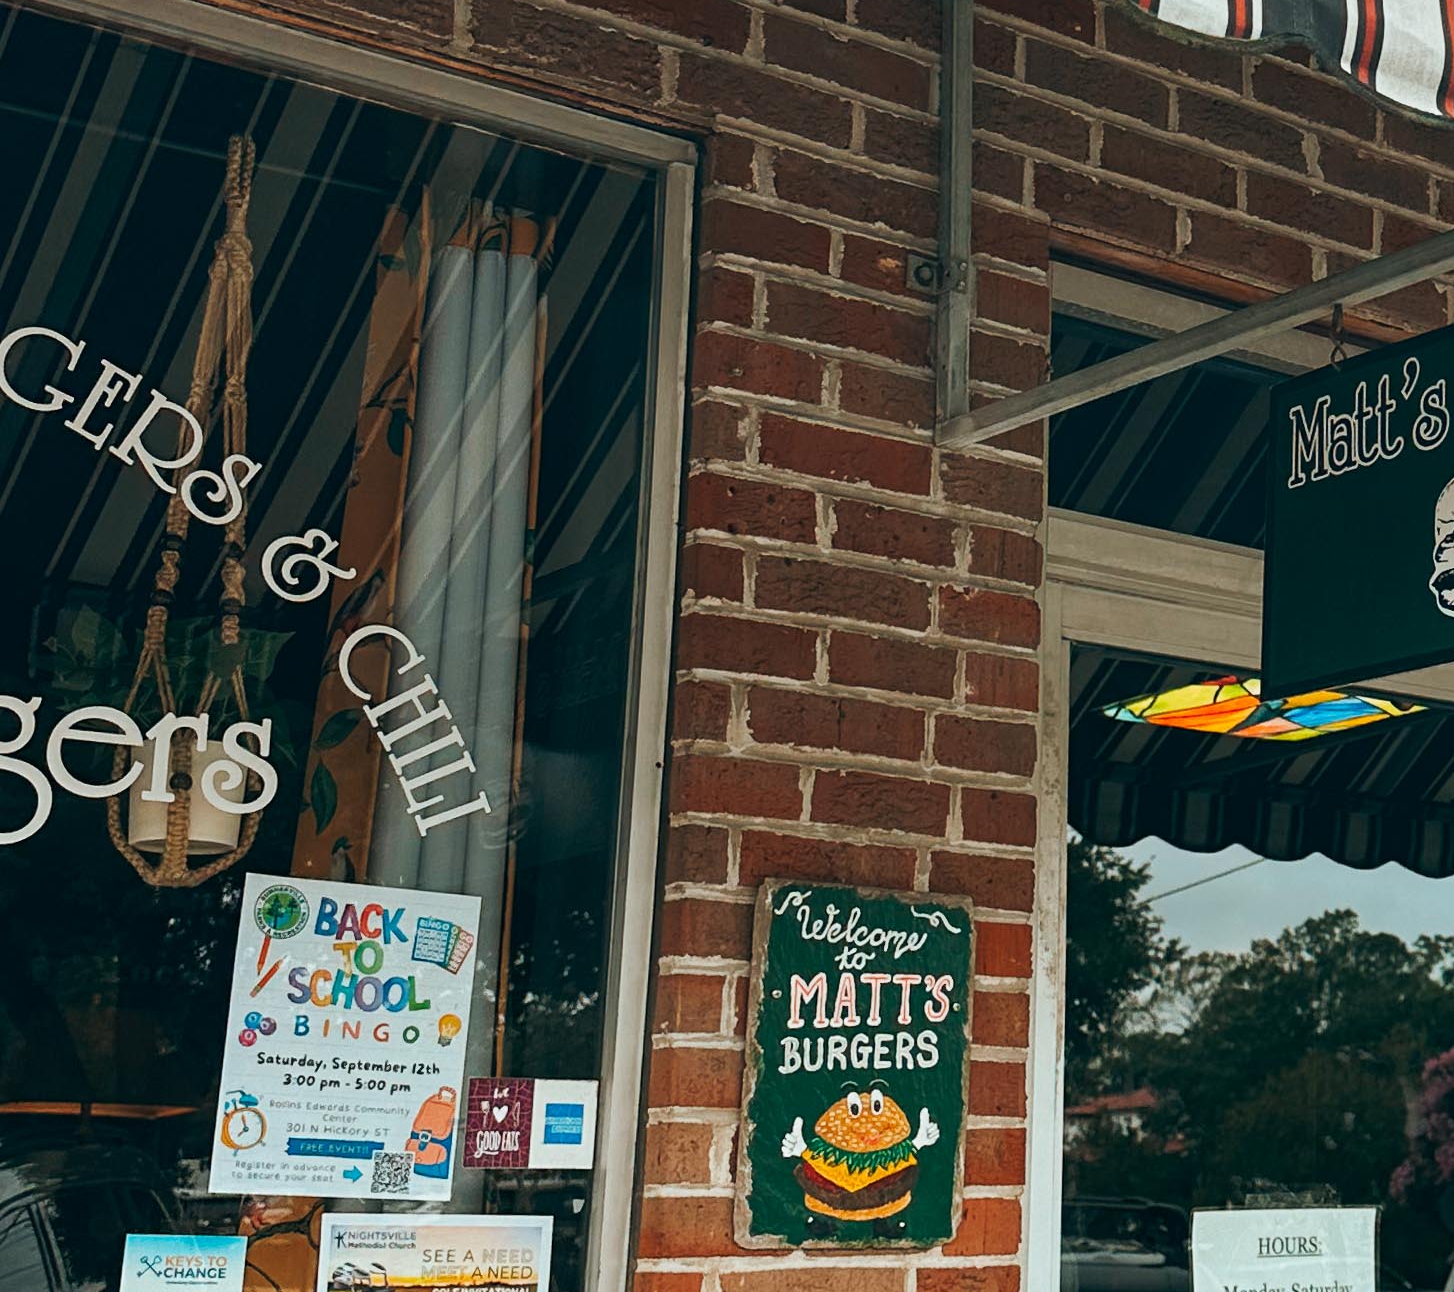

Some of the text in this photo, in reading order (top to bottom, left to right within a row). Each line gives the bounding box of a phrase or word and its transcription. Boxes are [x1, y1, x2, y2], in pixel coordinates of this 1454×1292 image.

[1288, 357, 1450, 488] Matt's
[0, 327, 491, 837] GERS & CHILI
[314, 896, 409, 945] BACK
[796, 904, 928, 960] Welcome
[333, 940, 384, 978] TO
[834, 947, 875, 971] to
[287, 966, 431, 1012] SCHOOL
[786, 971, 954, 1030] MATT'S
[293, 1014, 420, 1044] BINGO
[257, 1052, 440, 1075] Saturday, September 12th
[778, 1030, 940, 1075] BURGERS
[283, 1074, 316, 1086] 3:00
[320, 1079, 340, 1090] pm
[355, 1078, 386, 1091] 5:00
[390, 1083, 411, 1095] pm
[306, 1102, 350, 1112] Edwards
[354, 1104, 410, 1117] Community
[322, 1113, 358, 1122] Center
[286, 1123, 390, 1137] 301 N Hickory ST
[300, 1142, 324, 1153] FREE
[473, 1130, 520, 1159] GOOD EATS
[235, 1160, 337, 1173] Register in advance
[247, 1172, 281, 1181] secure
[422, 1249, 533, 1263] SEE A NEED
[1258, 1236, 1322, 1256] HOURS:
[165, 1256, 227, 1267] KEYS TO
[471, 1266, 483, 1279] A
[487, 1266, 533, 1279] NEED
[164, 1268, 227, 1279] CHANGE
